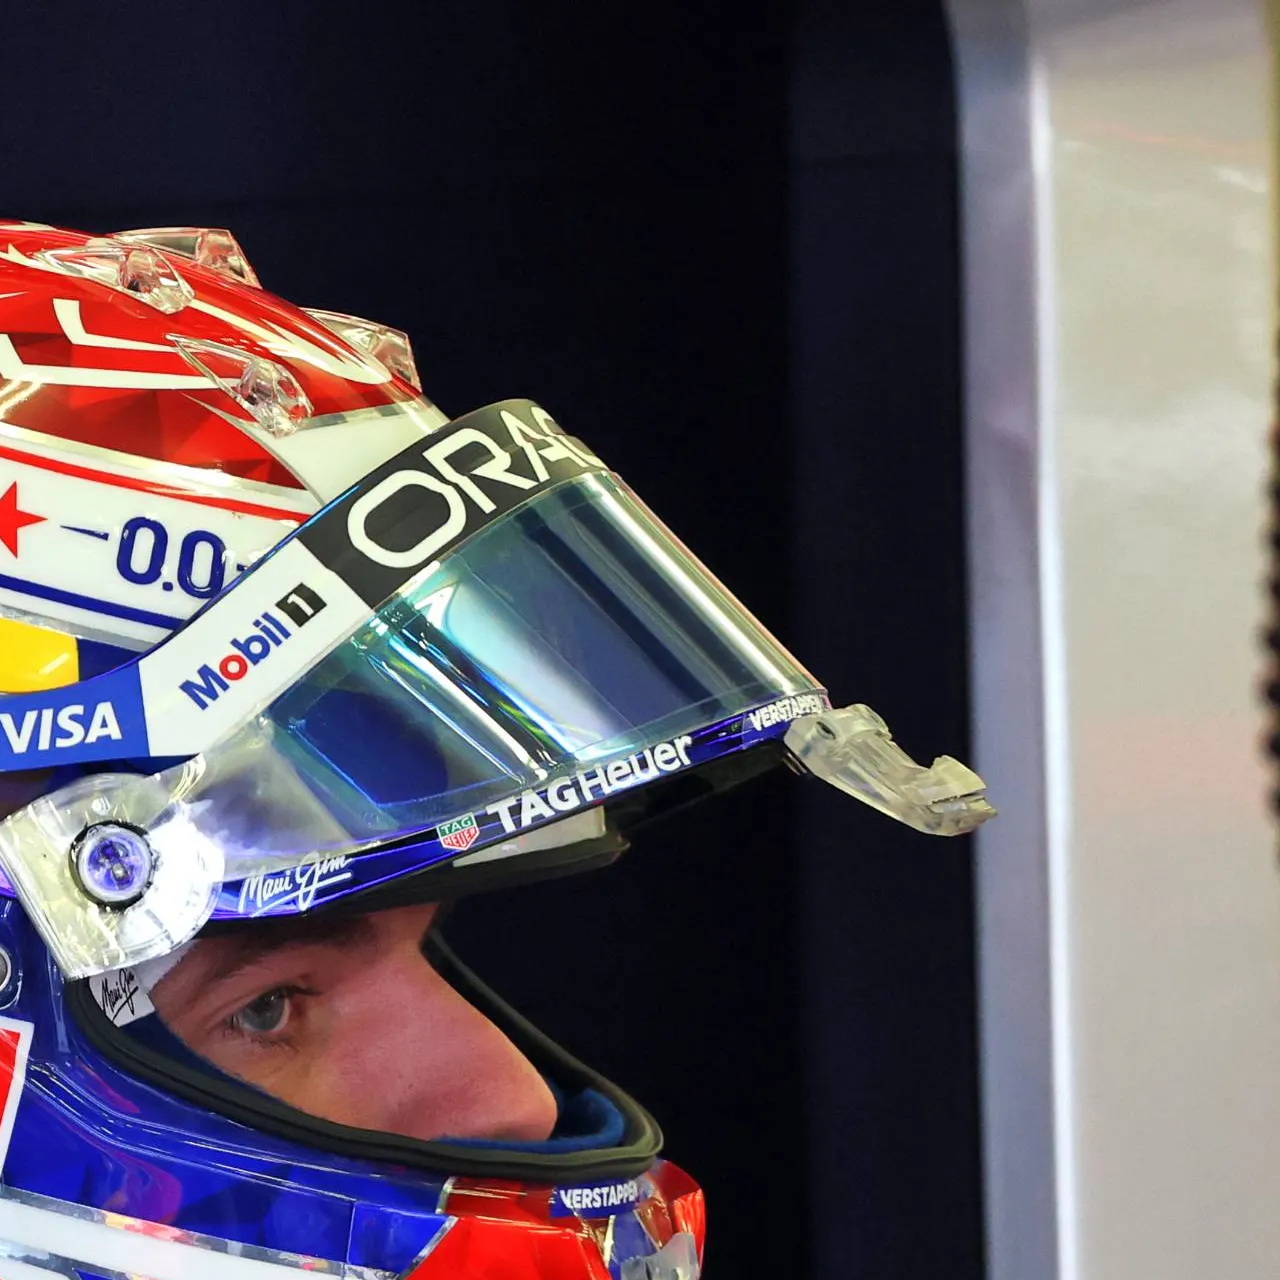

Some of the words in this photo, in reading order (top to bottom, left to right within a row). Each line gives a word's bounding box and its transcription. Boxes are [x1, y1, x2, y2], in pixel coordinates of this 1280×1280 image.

[178, 611, 292, 711] Mobil
[440, 816, 474, 835] TAG
[238, 868, 294, 914] Maui
